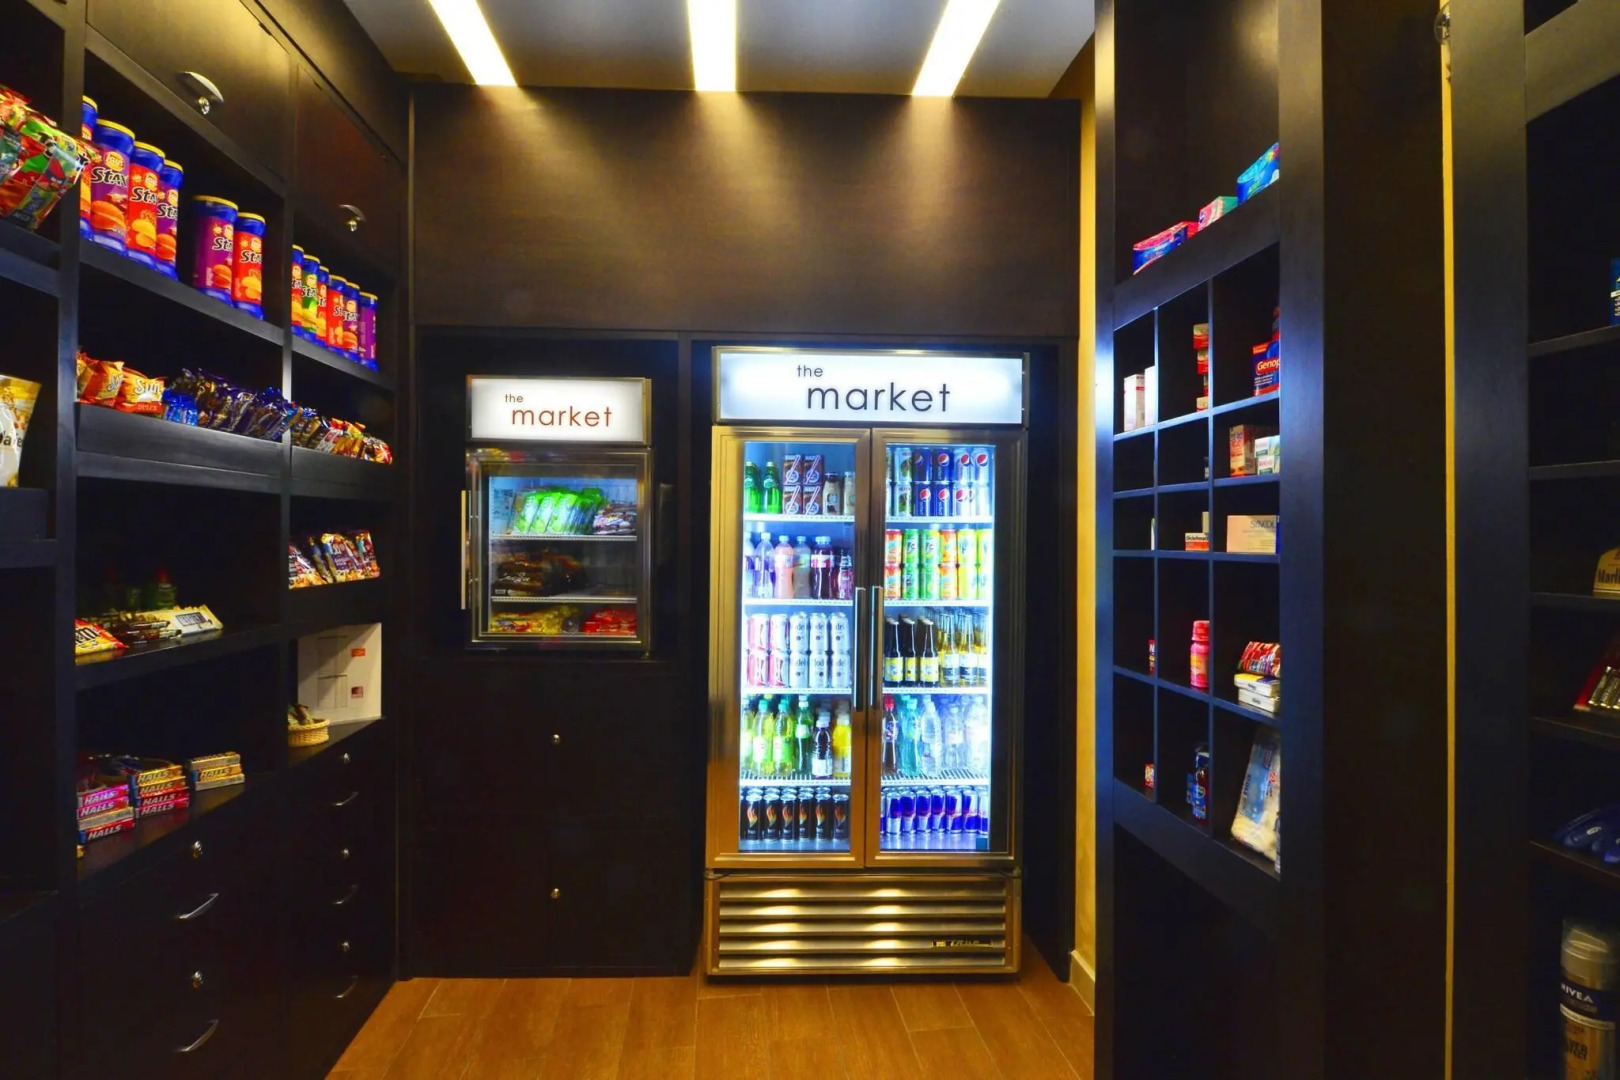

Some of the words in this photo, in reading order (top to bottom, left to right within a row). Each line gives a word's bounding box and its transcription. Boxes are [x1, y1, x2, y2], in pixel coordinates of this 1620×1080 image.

[797, 365, 823, 378] the
[505, 394, 524, 403] the
[807, 382, 950, 412] market
[512, 405, 612, 427] market
[137, 771, 169, 783] HALLS
[200, 768, 230, 778] HALLS
[140, 782, 173, 795] HALLS
[84, 790, 116, 805] HALLS
[142, 793, 176, 806] HALLS
[80, 801, 115, 817] HALLS
[141, 803, 175, 815] HALLS
[87, 824, 121, 840] HALLS
